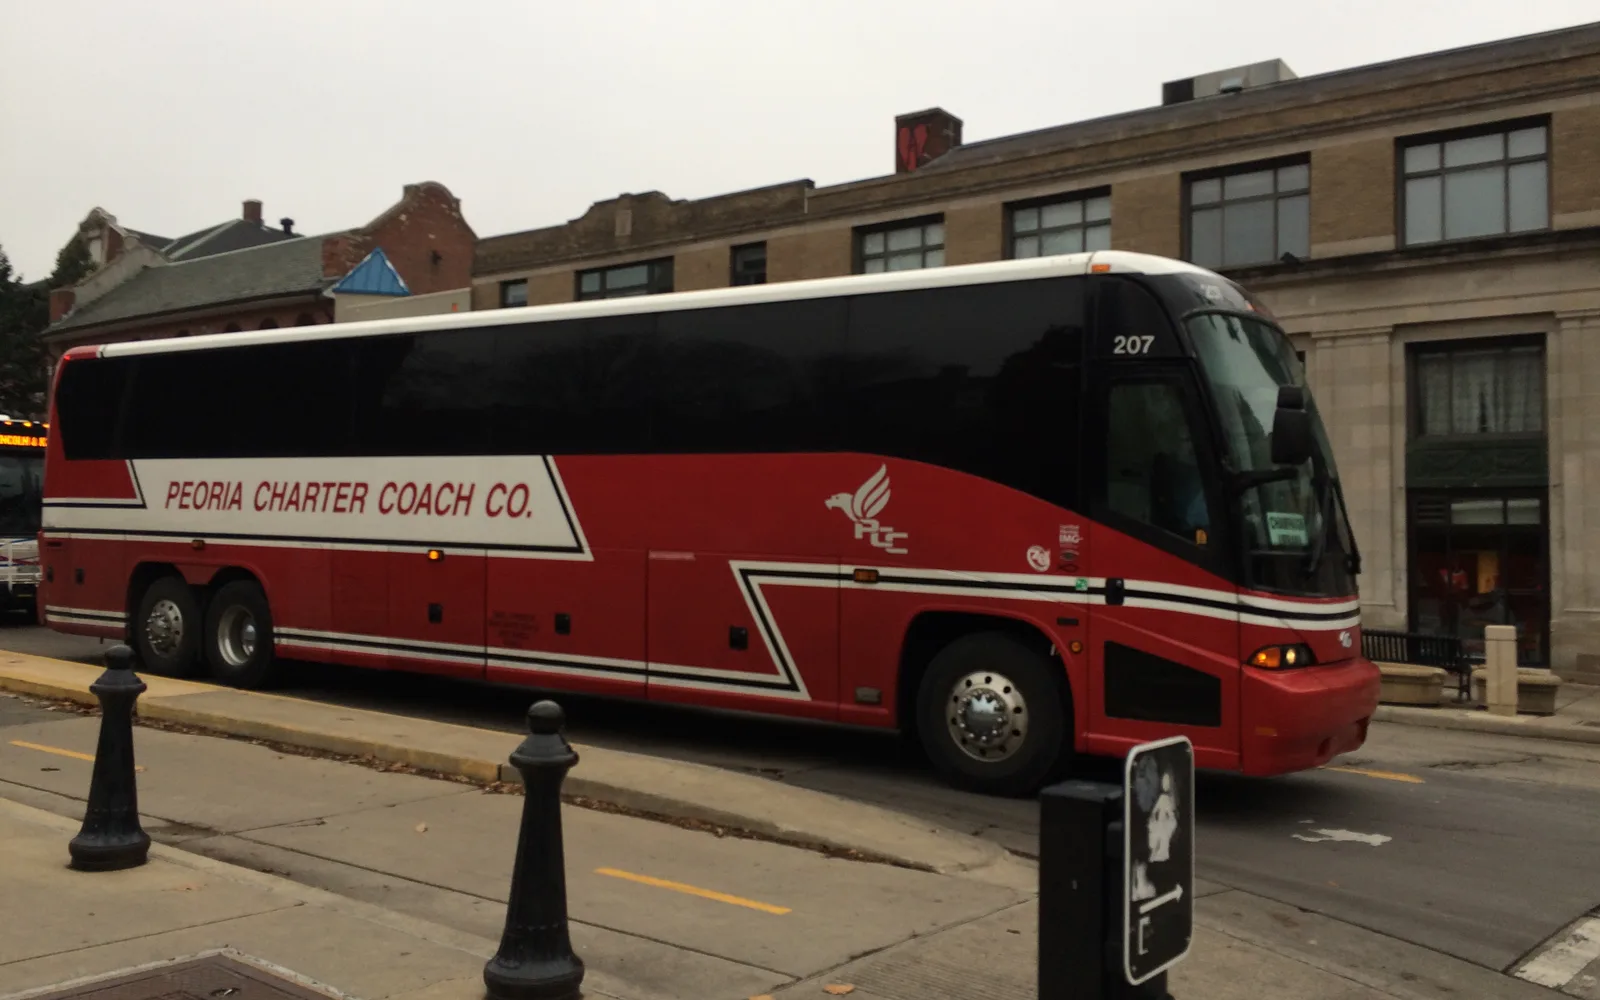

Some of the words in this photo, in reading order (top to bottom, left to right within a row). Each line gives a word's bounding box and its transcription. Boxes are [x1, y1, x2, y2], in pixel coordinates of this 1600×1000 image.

[1113, 335, 1155, 355] 207
[165, 480, 243, 511] PEORIA
[253, 480, 369, 514] CHARTER
[378, 481, 476, 517] COACH
[485, 482, 532, 519] CO.
